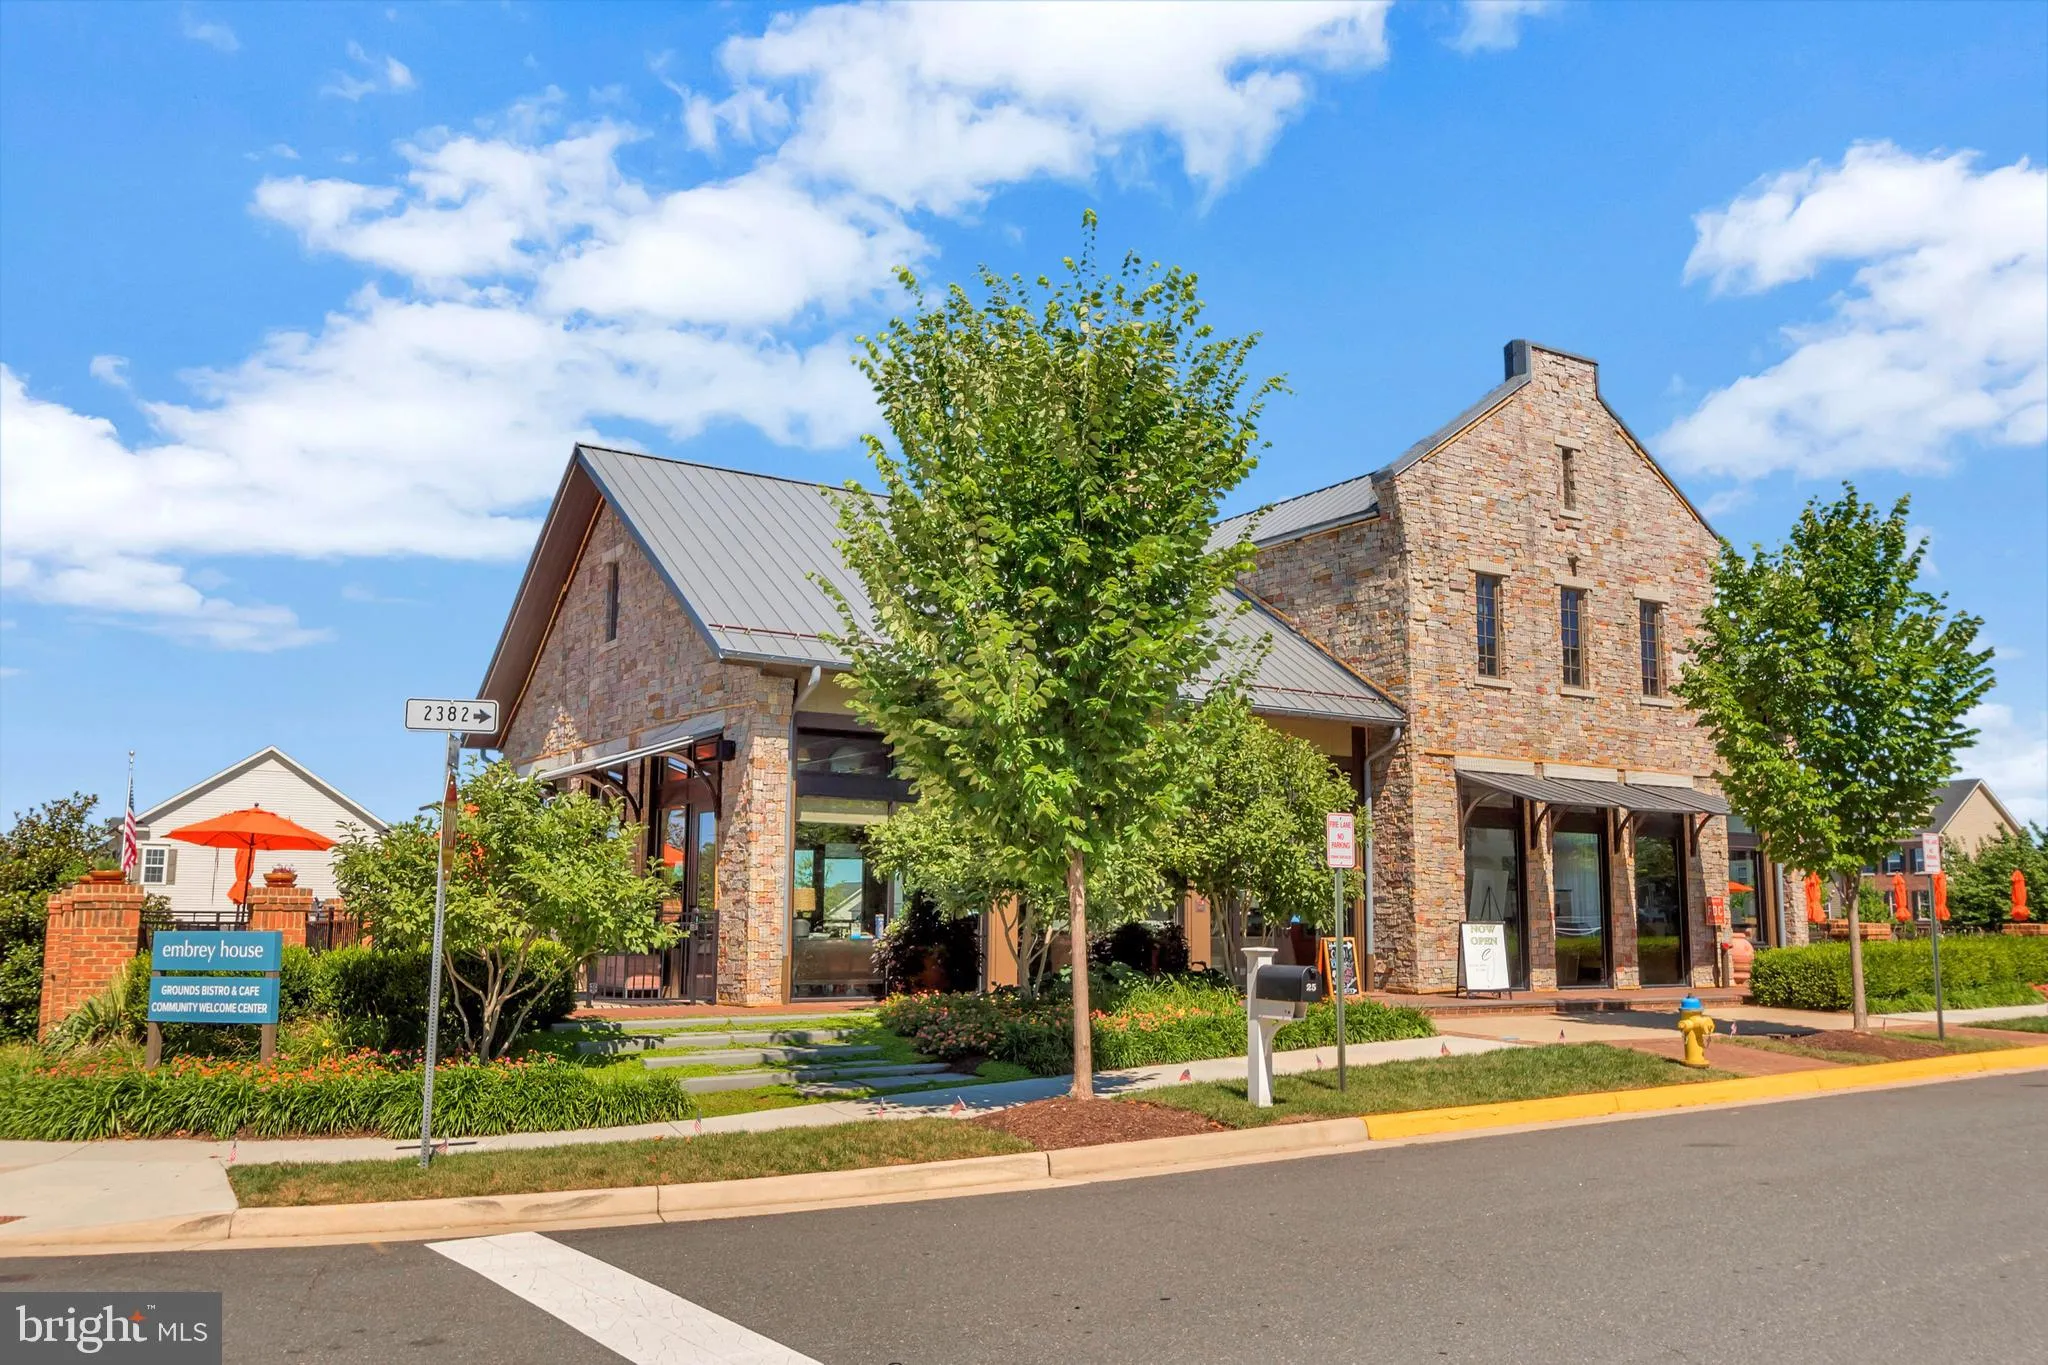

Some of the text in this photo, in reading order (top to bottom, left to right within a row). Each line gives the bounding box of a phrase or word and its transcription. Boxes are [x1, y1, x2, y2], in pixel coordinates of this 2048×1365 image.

[424, 705, 469, 722] 2382
[1470, 926, 1496, 934] NOW
[1470, 937, 1498, 946] OPEN
[162, 940, 264, 963] embrey house
[161, 985, 260, 996] GROUNDS BISTRO & CAFE
[1306, 983, 1317, 992] 25
[151, 1002, 268, 1014] COMMUNITY WELCOME CENTER
